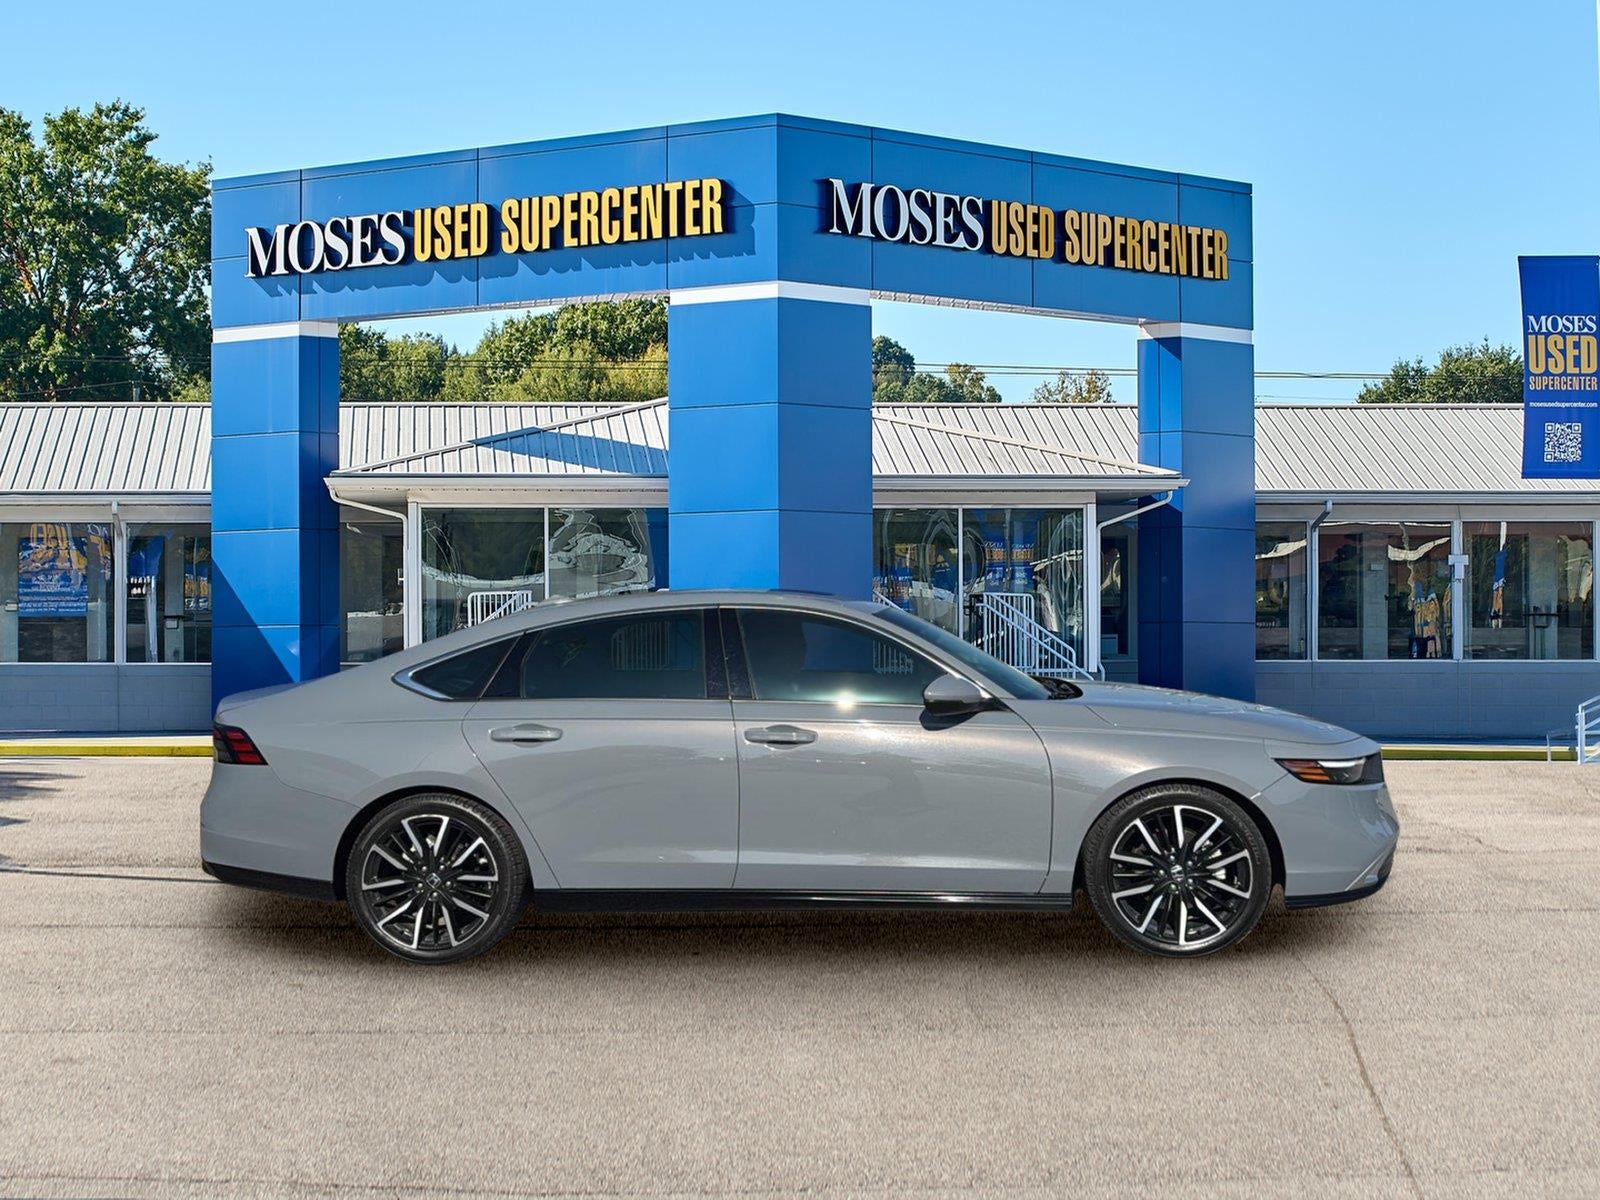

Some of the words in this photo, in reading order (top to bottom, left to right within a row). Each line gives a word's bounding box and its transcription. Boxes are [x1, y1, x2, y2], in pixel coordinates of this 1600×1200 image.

[245, 211, 406, 278] MOSES
[413, 202, 489, 262] USED
[501, 178, 723, 254] SUPERCENTER
[828, 178, 985, 251] MOSES
[991, 199, 1055, 259] USED
[1065, 209, 1229, 280] SUPERCENTER
[1527, 315, 1597, 333] MOSES
[1528, 335, 1598, 374] USED
[1529, 376, 1598, 390] SUPERCENTER
